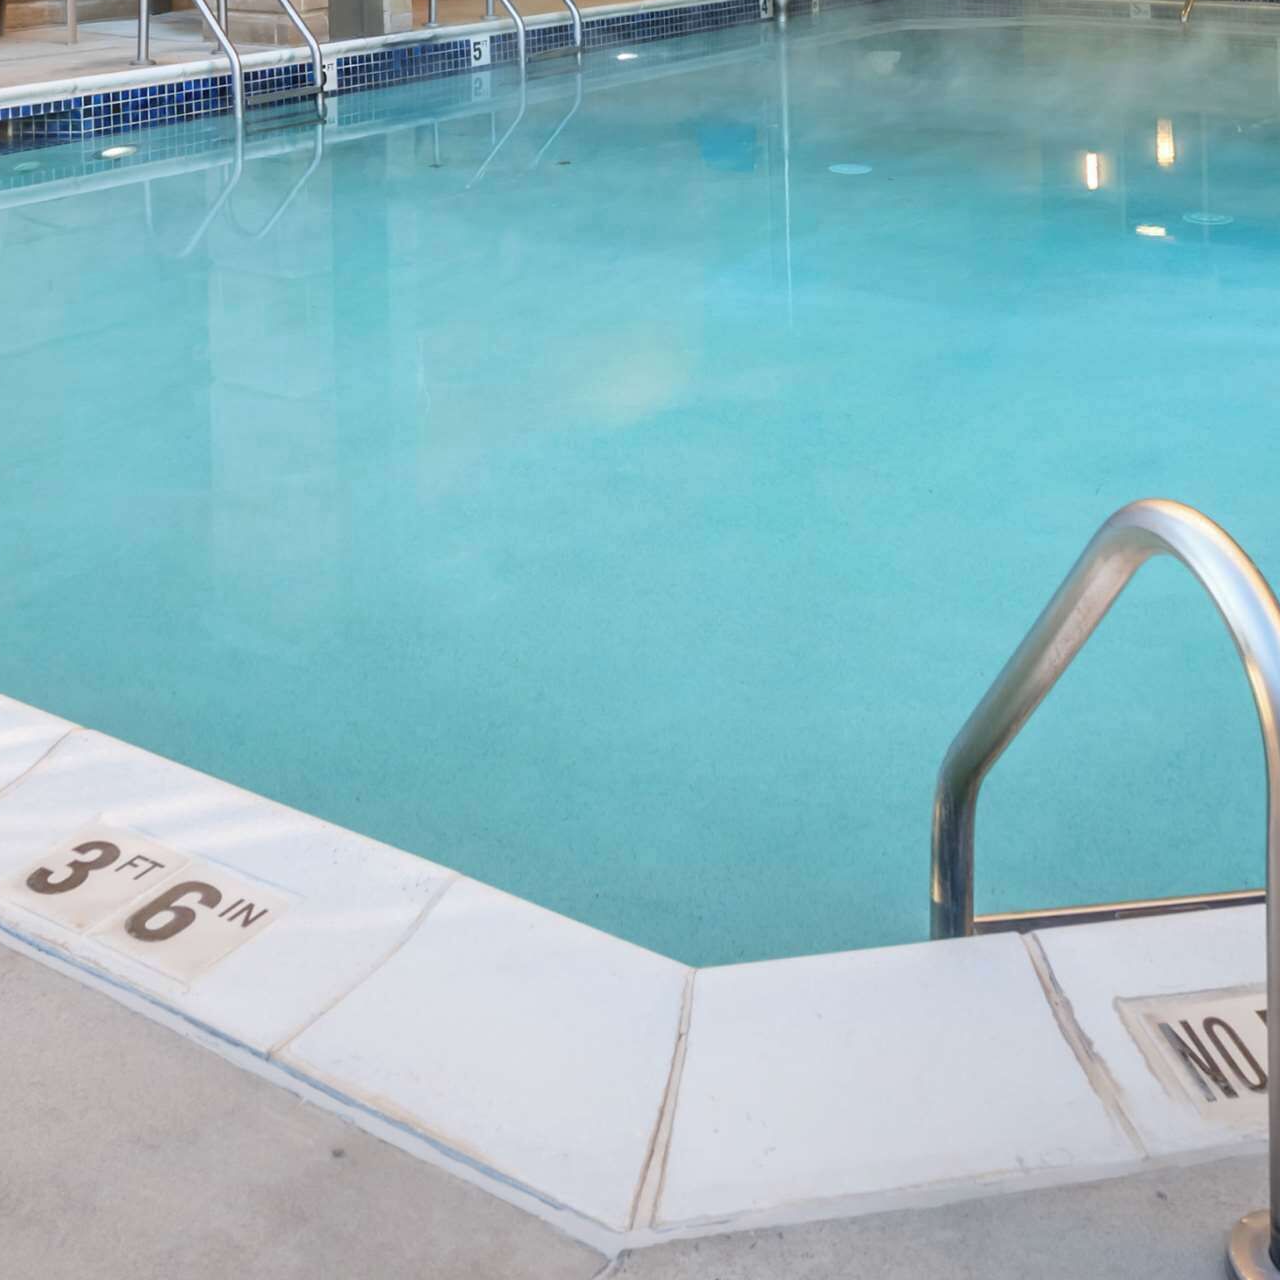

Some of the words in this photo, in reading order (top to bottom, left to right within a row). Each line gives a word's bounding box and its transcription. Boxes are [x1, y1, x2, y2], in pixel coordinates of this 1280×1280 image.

[473, 41, 482, 61] 5
[26, 841, 120, 895] 3
[115, 855, 165, 880] FT
[124, 881, 223, 942] 6
[218, 899, 268, 928] IN
[1159, 1017, 1267, 1102] NO
